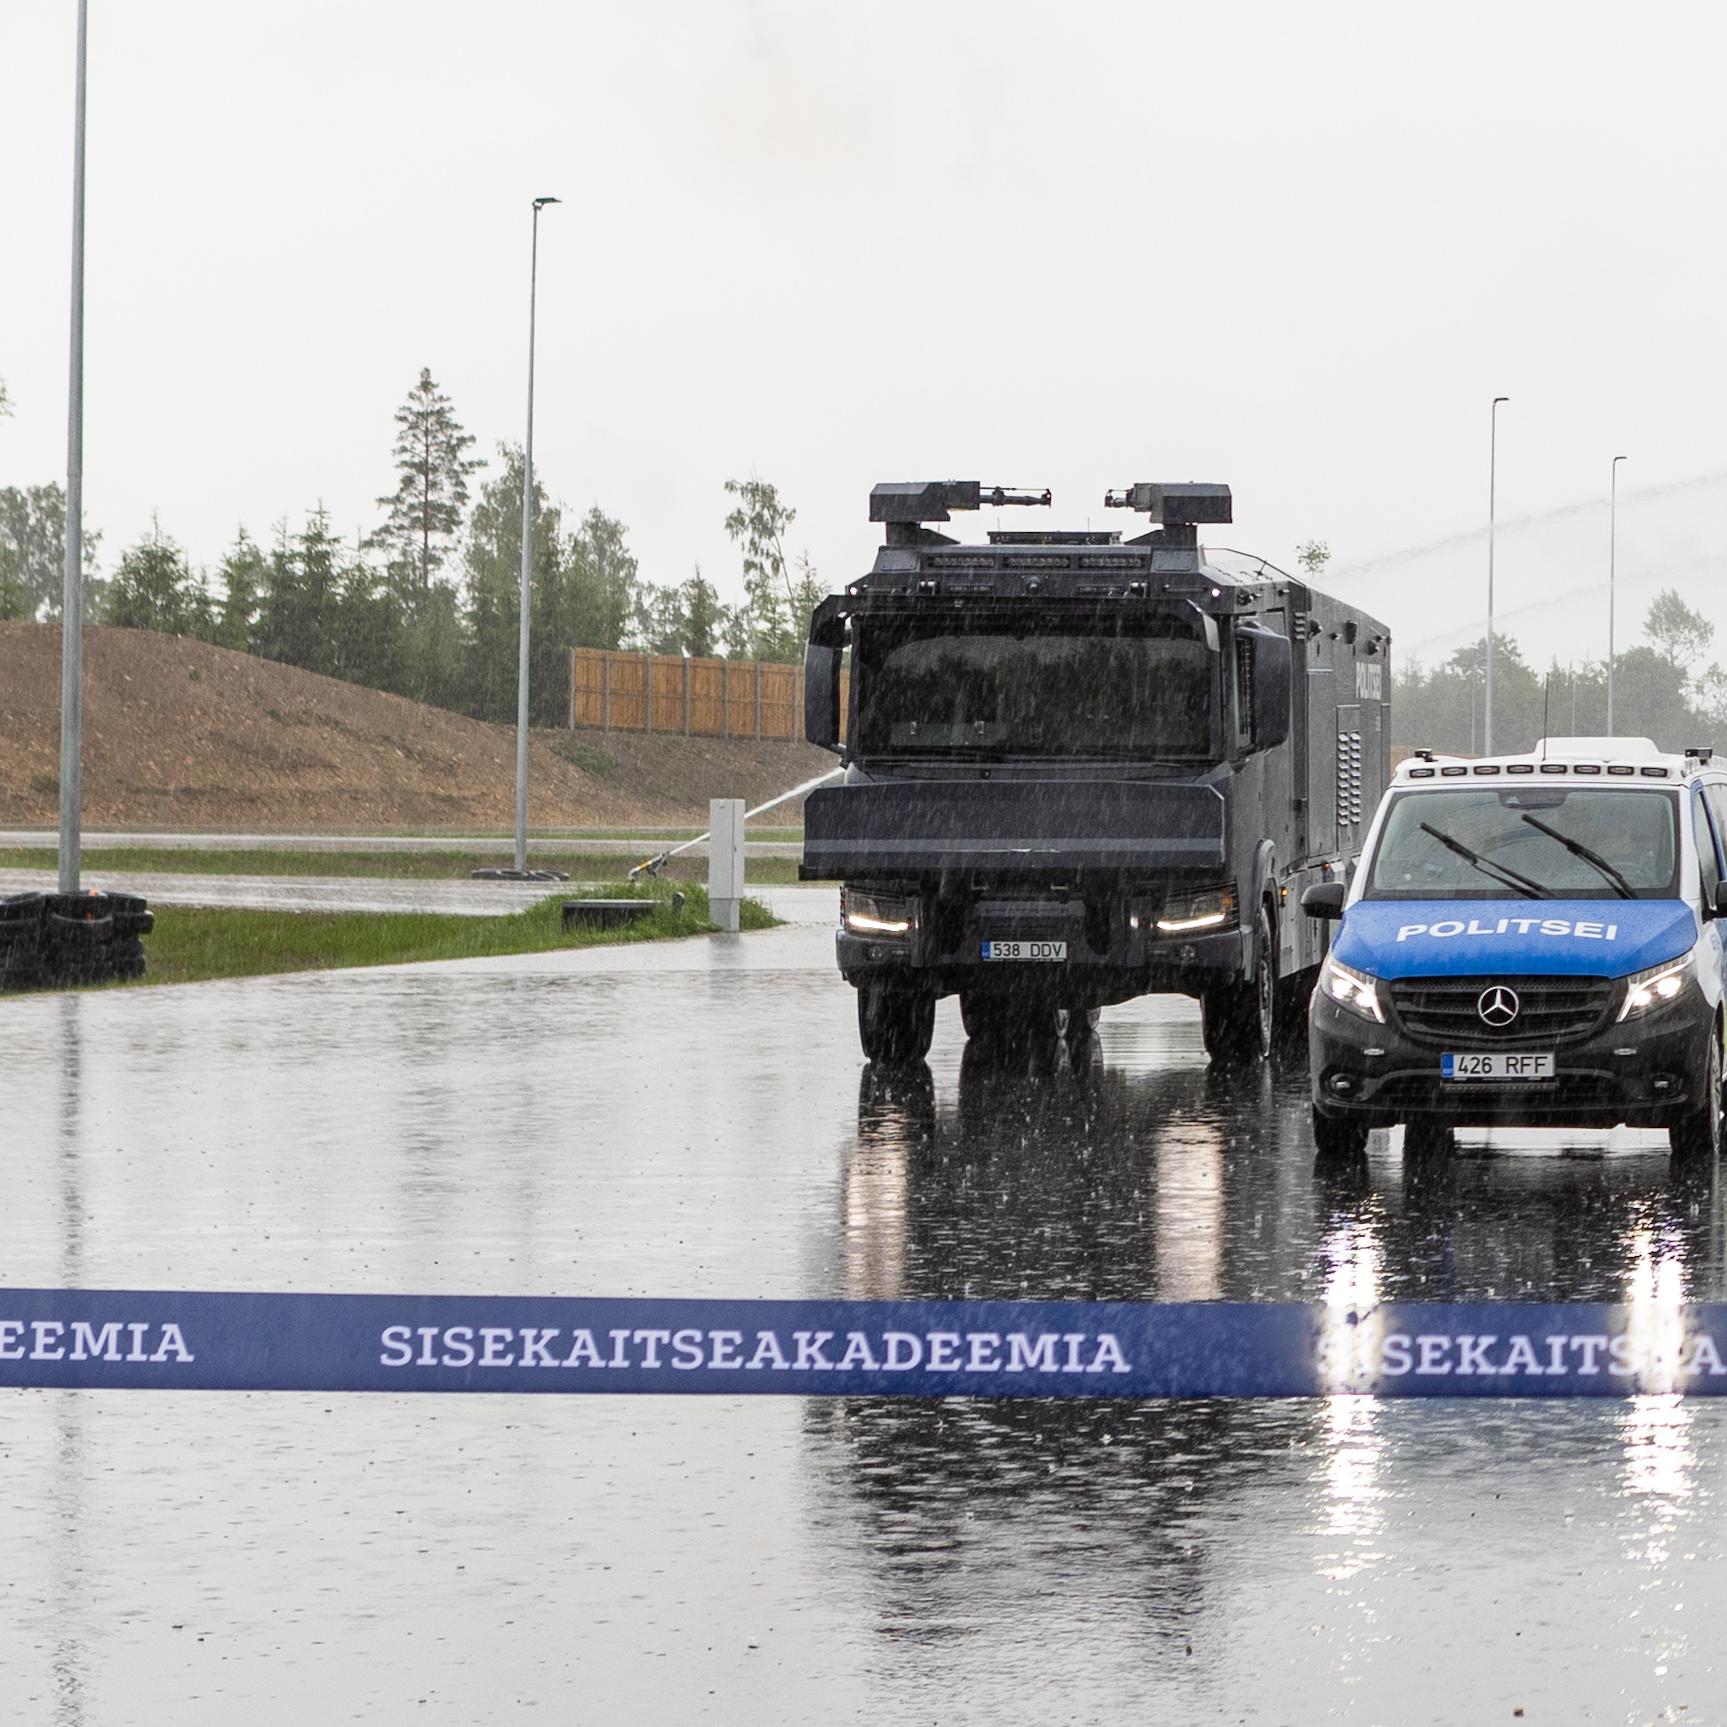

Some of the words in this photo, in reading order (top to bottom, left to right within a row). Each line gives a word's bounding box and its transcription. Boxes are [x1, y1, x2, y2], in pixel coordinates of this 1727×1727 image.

[1396, 919, 1618, 942] POLITSEI
[993, 943, 1021, 957] 538
[1030, 943, 1063, 957] DDV
[1458, 1056, 1493, 1075] 426
[1505, 1056, 1548, 1074] RFF
[0, 1320, 195, 1362] EEMIA
[379, 1325, 1132, 1374] SISEKAITSEAKADEEMIA
